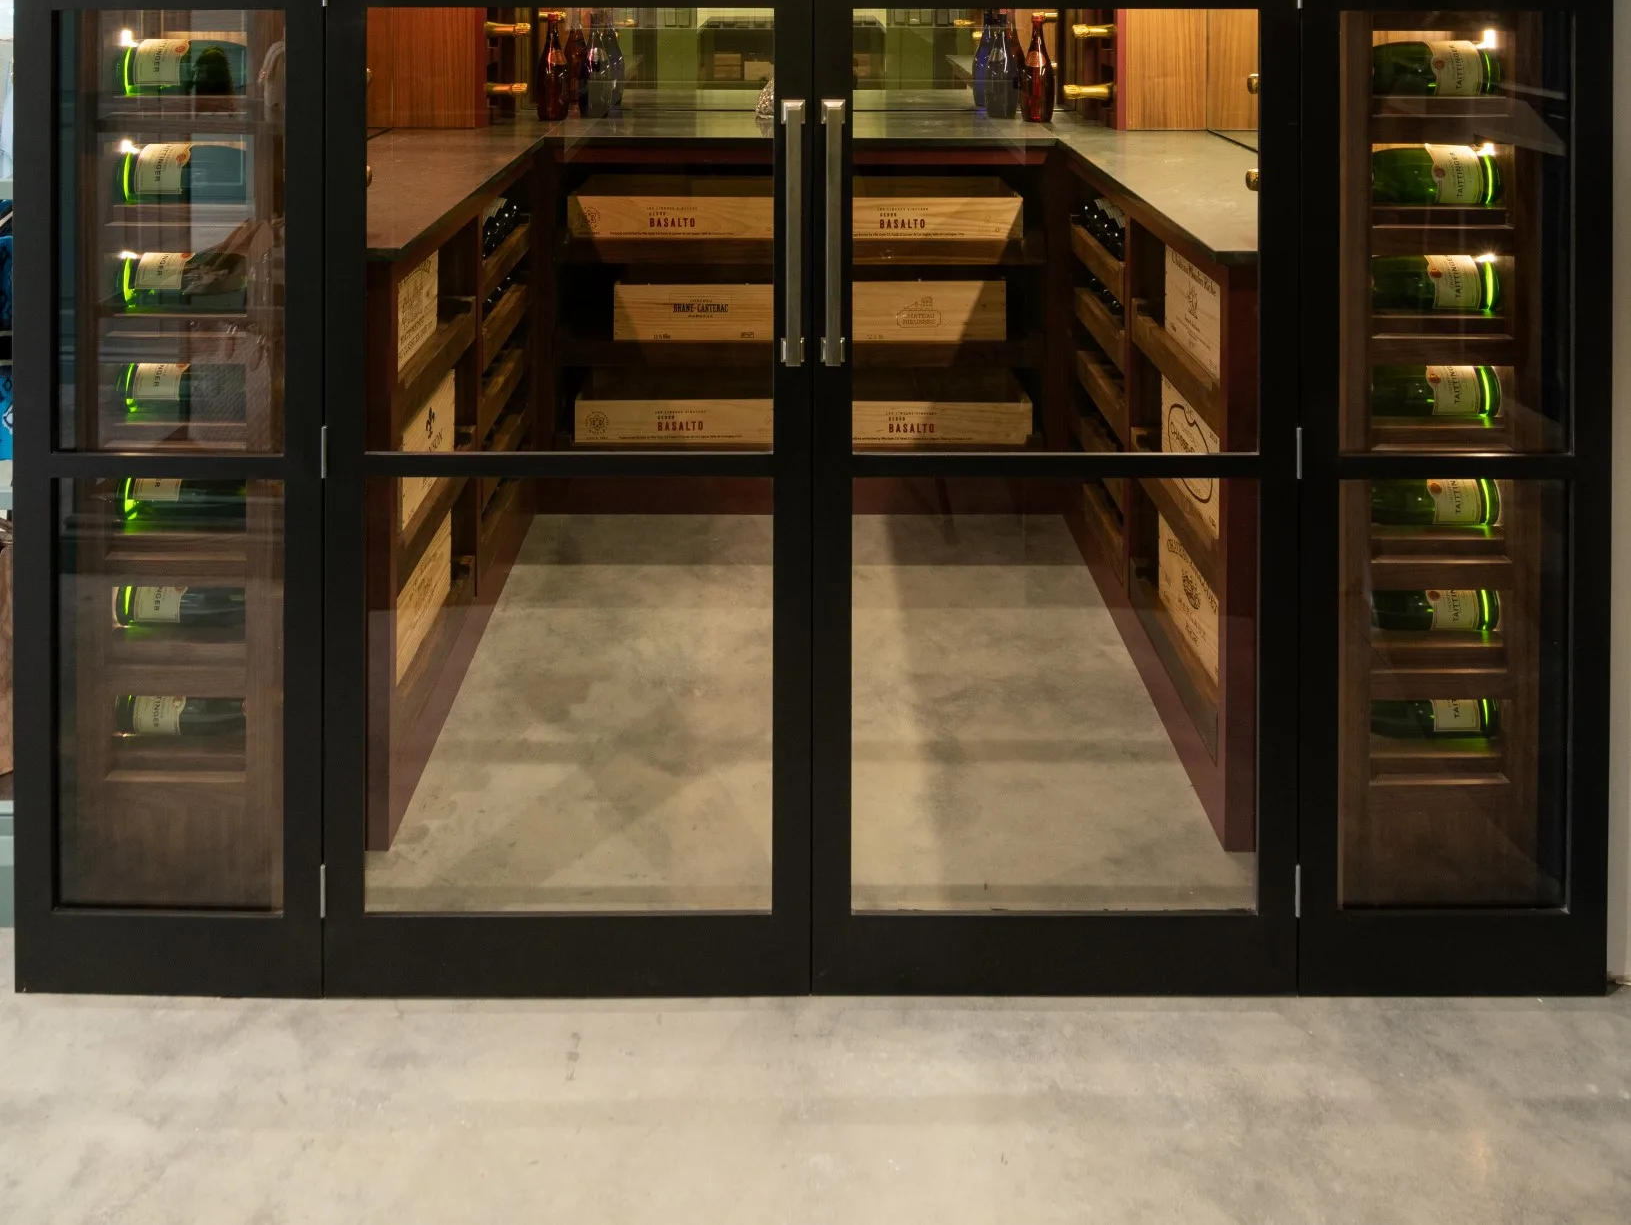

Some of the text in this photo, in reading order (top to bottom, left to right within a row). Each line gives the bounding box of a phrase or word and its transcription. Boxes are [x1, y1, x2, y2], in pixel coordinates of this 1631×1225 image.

[650, 218, 695, 227] BASALTO
[880, 219, 925, 228] BASALTO
[658, 421, 703, 431] BASALTO
[889, 424, 935, 433] BASALTO
